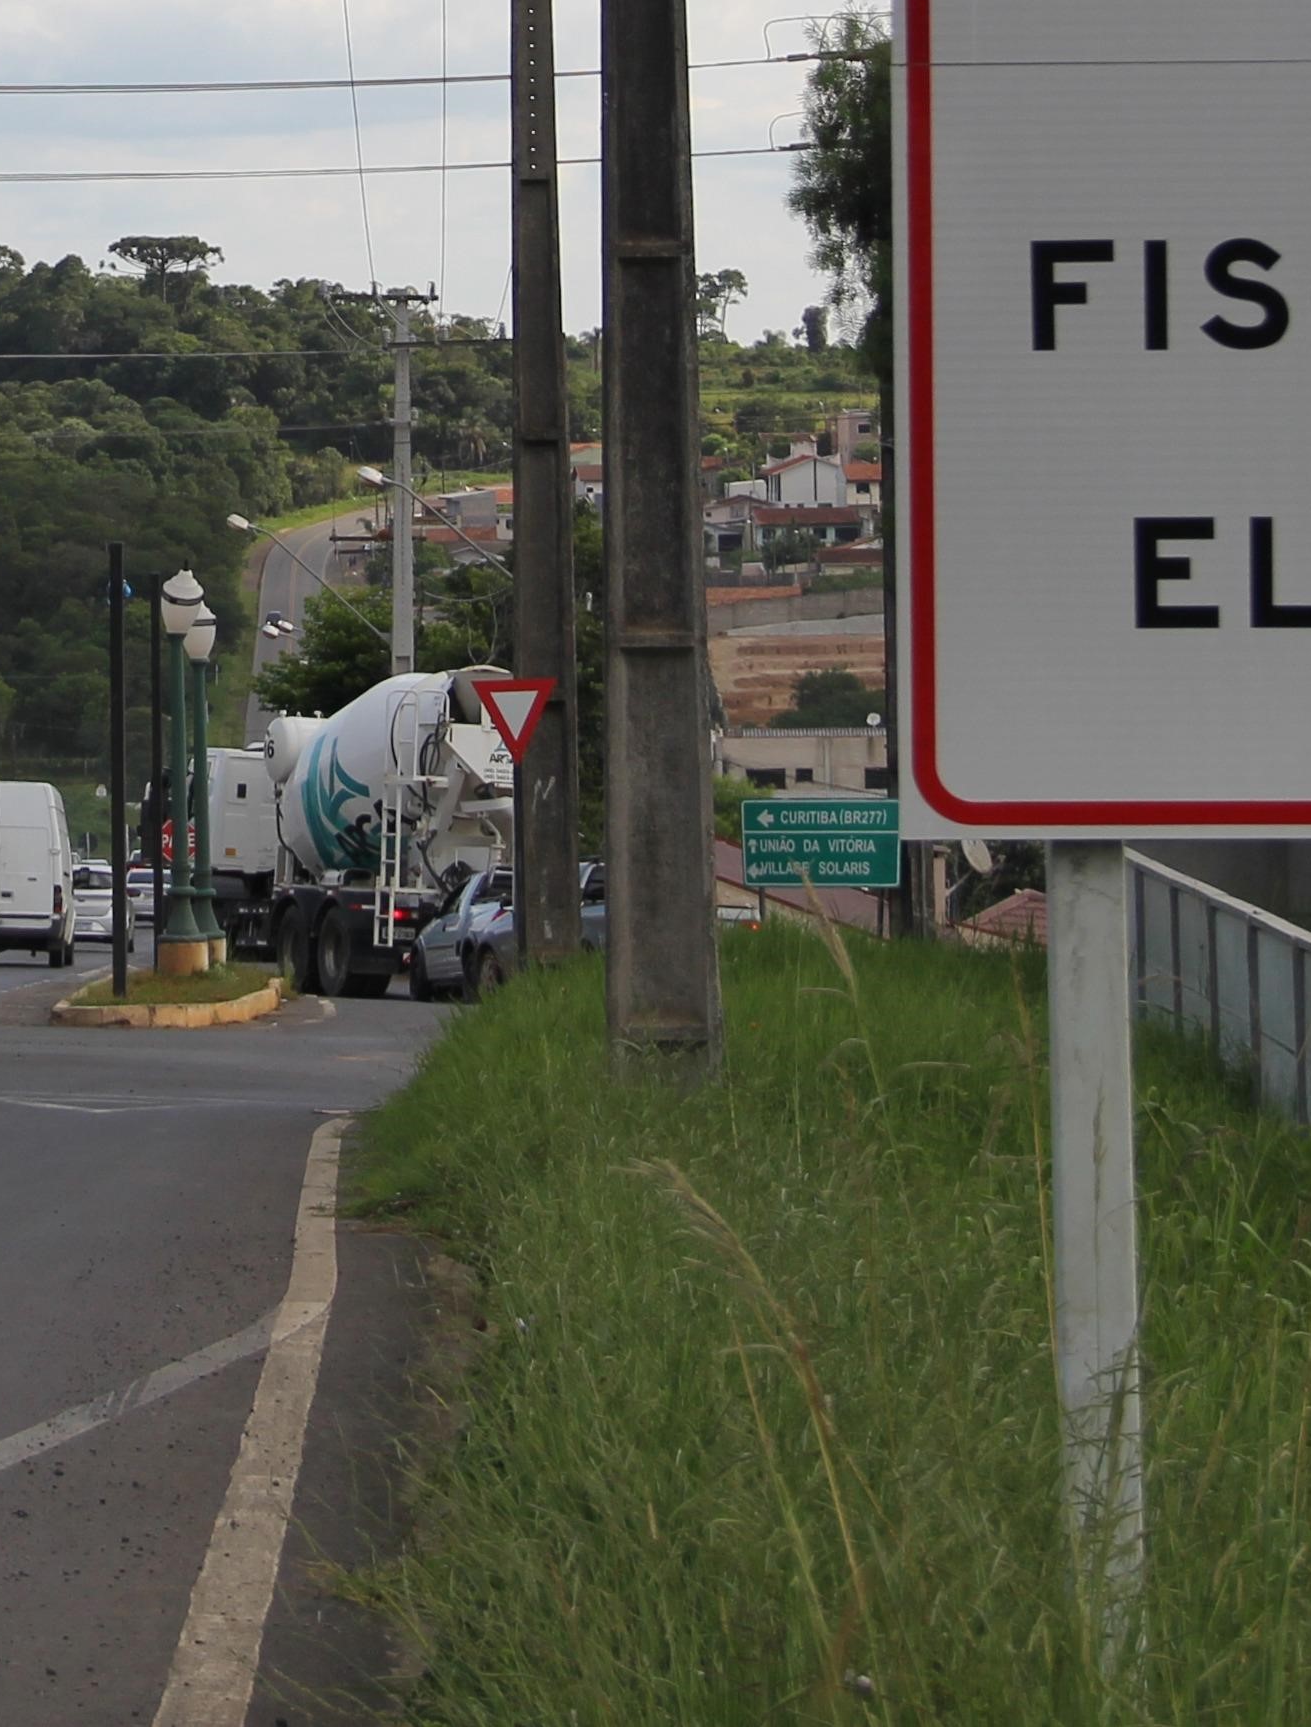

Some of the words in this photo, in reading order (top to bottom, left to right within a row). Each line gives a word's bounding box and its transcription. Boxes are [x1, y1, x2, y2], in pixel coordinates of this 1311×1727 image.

[1030, 237, 1290, 351] FIS
[1134, 516, 1311, 629] EL
[760, 835, 795, 853] UNIÃO
[803, 839, 820, 852] DA
[828, 836, 876, 853] VITÓRIA
[818, 861, 871, 876] SOLARIS
